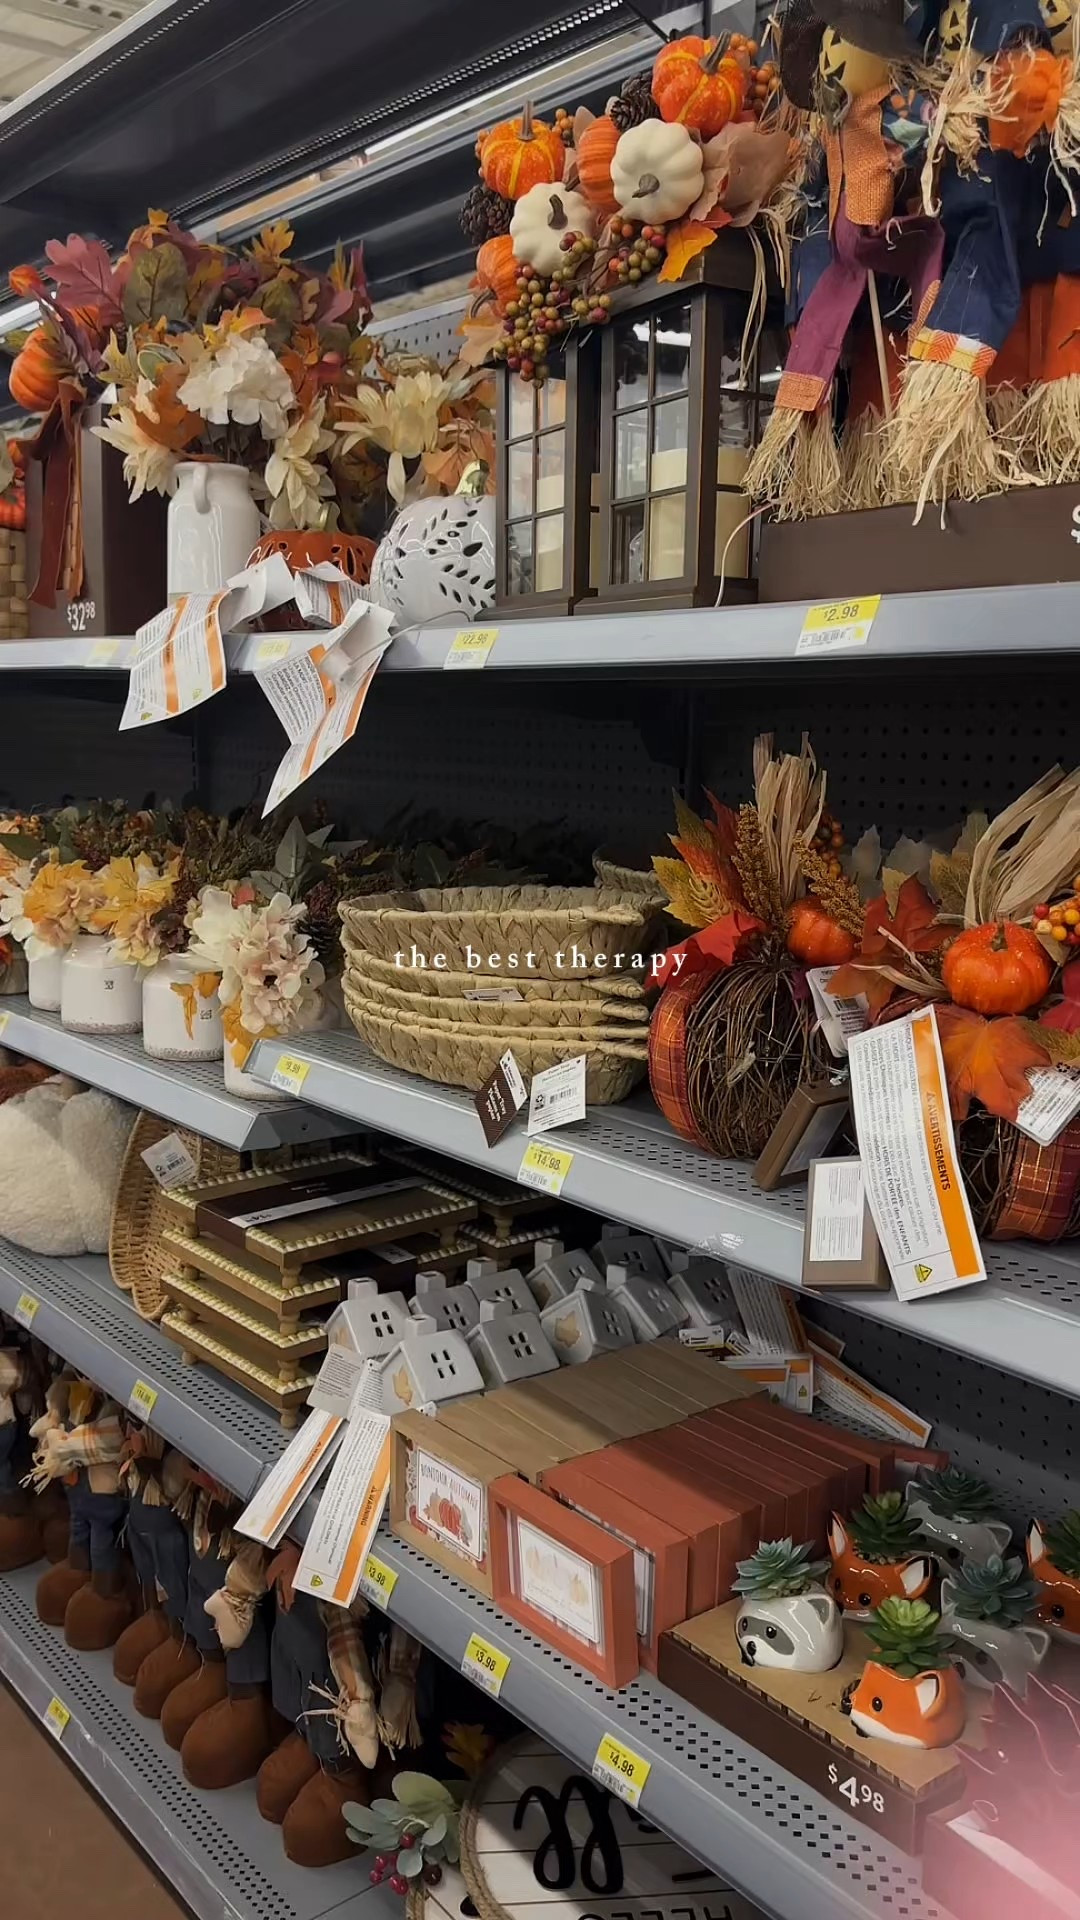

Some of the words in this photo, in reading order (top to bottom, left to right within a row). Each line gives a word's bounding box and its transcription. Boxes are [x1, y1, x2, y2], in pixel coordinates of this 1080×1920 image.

[824, 604, 859, 621] $2.98
[925, 1102, 951, 1191] AVERTISSEMENTS
[895, 1220, 912, 1255] ENFANTS
[360, 1492, 375, 1527] WARNING
[610, 1751, 635, 1777] $4.98
